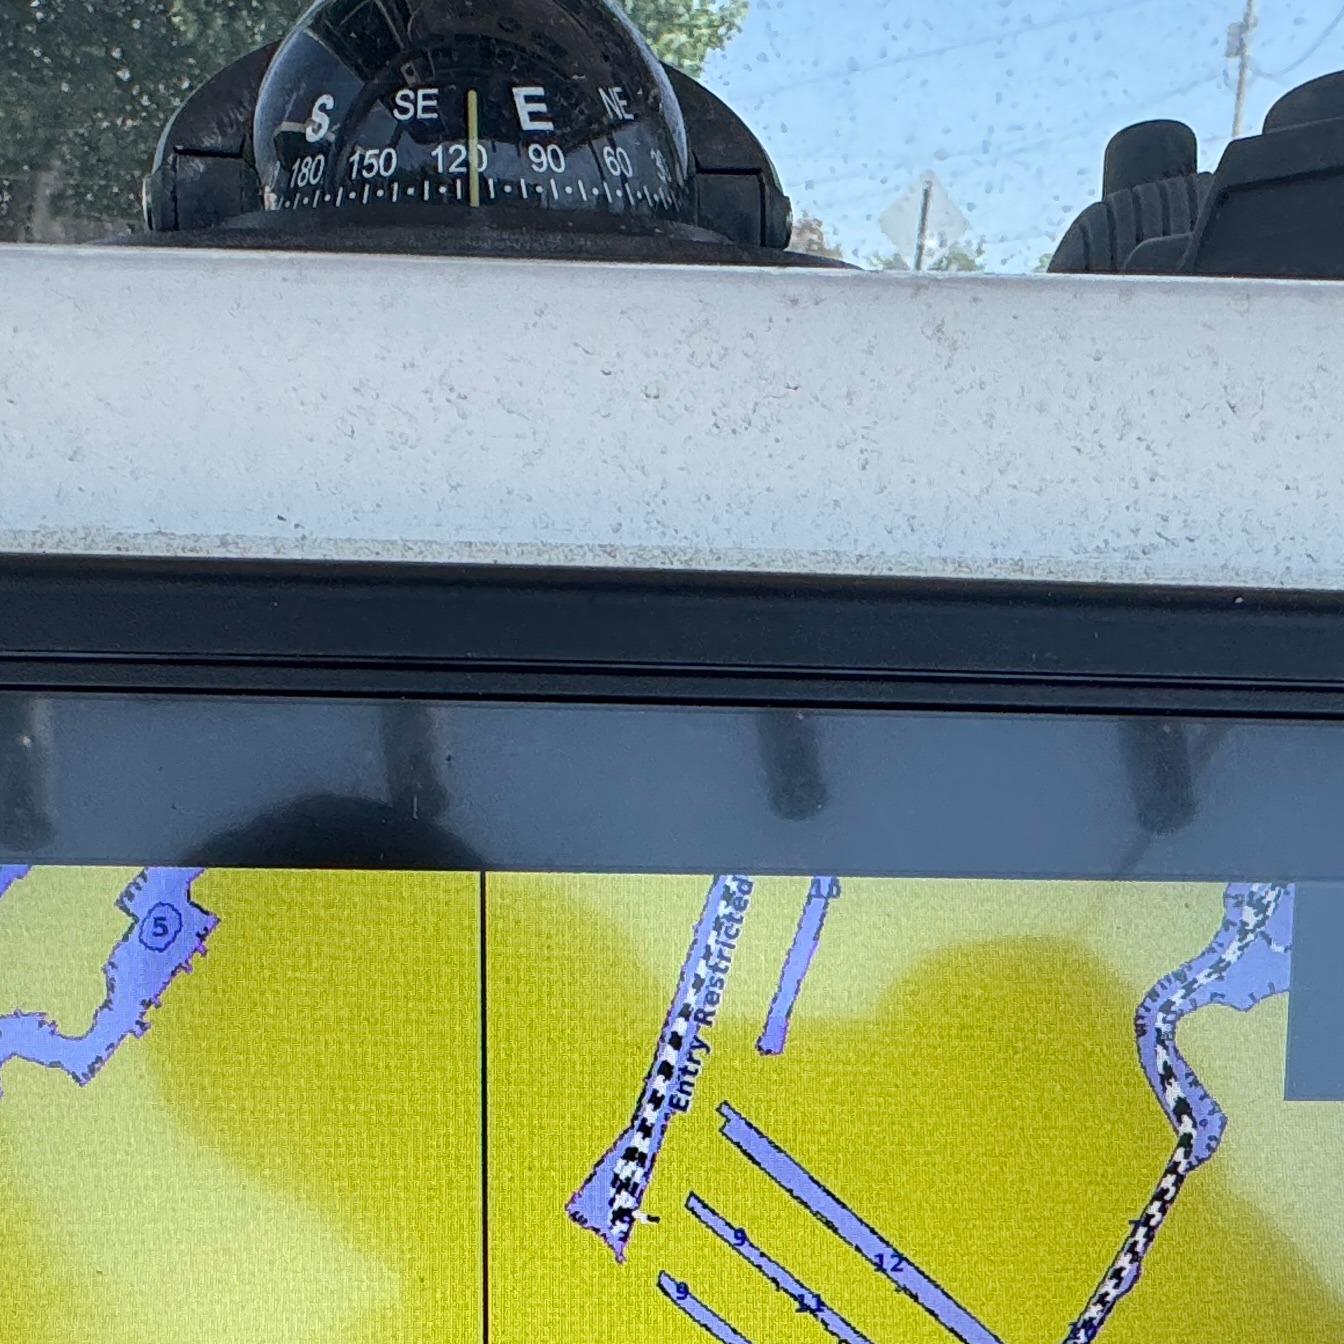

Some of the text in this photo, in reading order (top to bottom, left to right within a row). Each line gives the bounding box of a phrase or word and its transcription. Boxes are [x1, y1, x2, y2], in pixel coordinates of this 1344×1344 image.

[306, 86, 635, 142] S SE E NE
[289, 155, 326, 187] 180
[348, 148, 398, 179] 150
[430, 146, 489, 175] 120
[528, 144, 565, 174] 90
[602, 146, 634, 179] 60
[152, 917, 169, 937] 5
[671, 877, 754, 1114] Entry Restricted
[733, 1228, 748, 1247] 9
[874, 1254, 905, 1272] 12
